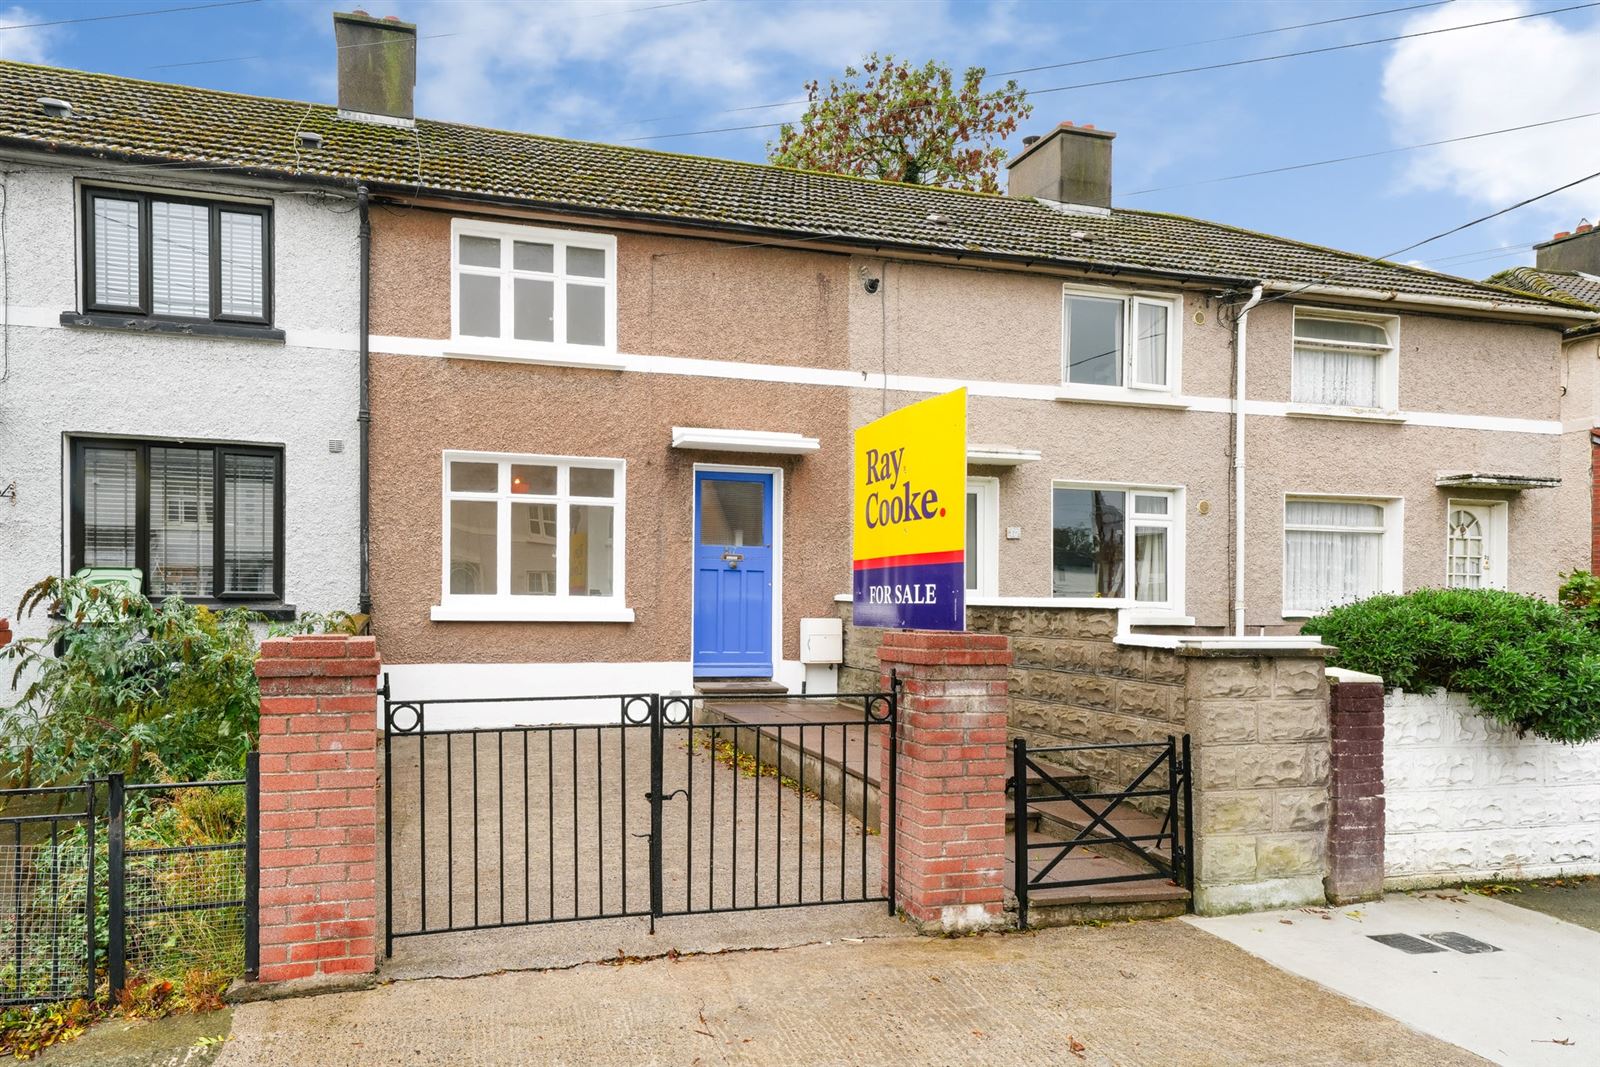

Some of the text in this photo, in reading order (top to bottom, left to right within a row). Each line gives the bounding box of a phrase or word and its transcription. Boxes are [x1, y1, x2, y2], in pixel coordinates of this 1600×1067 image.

[866, 447, 904, 490] Ray
[866, 481, 946, 529] Cooke.
[869, 584, 937, 604] FOR SALE
